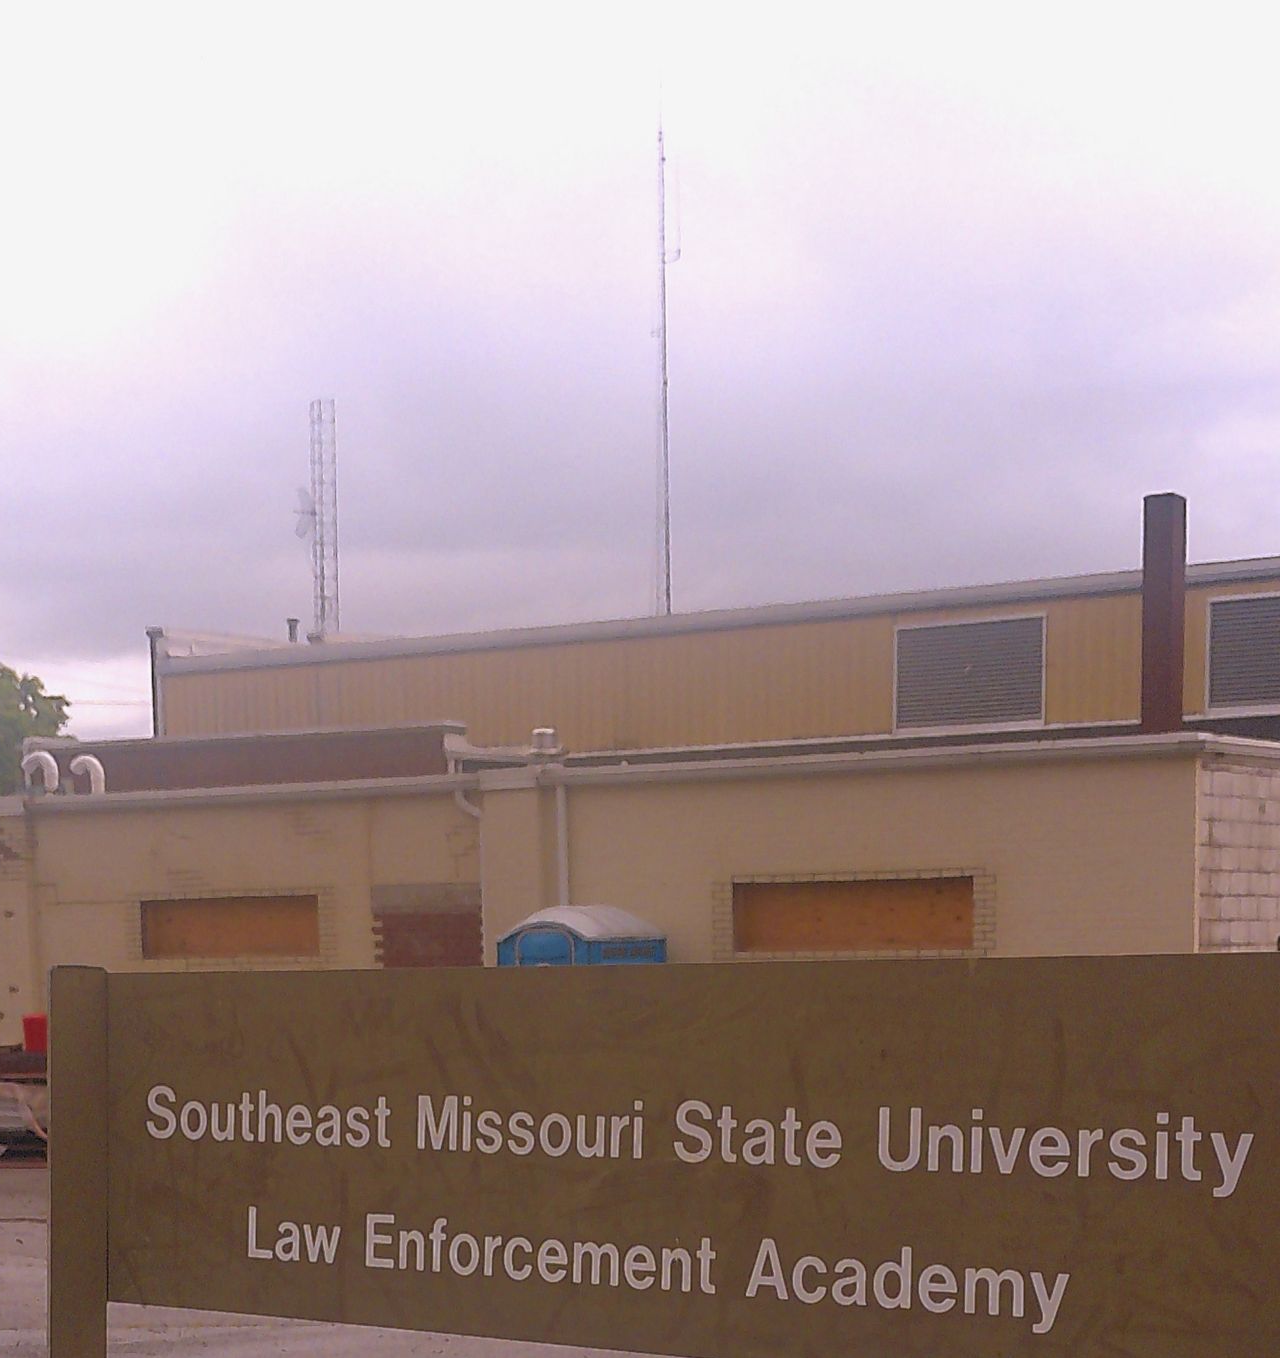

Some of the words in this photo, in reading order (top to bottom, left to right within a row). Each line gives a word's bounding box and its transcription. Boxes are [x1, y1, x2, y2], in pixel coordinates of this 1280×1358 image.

[145, 1084, 392, 1148] Southeast
[416, 1094, 644, 1159] Missouri
[673, 1099, 842, 1168] State
[877, 1106, 1254, 1198] University
[246, 1205, 341, 1264] Law
[365, 1213, 716, 1295] Enforcement
[745, 1238, 1071, 1334] Academy
